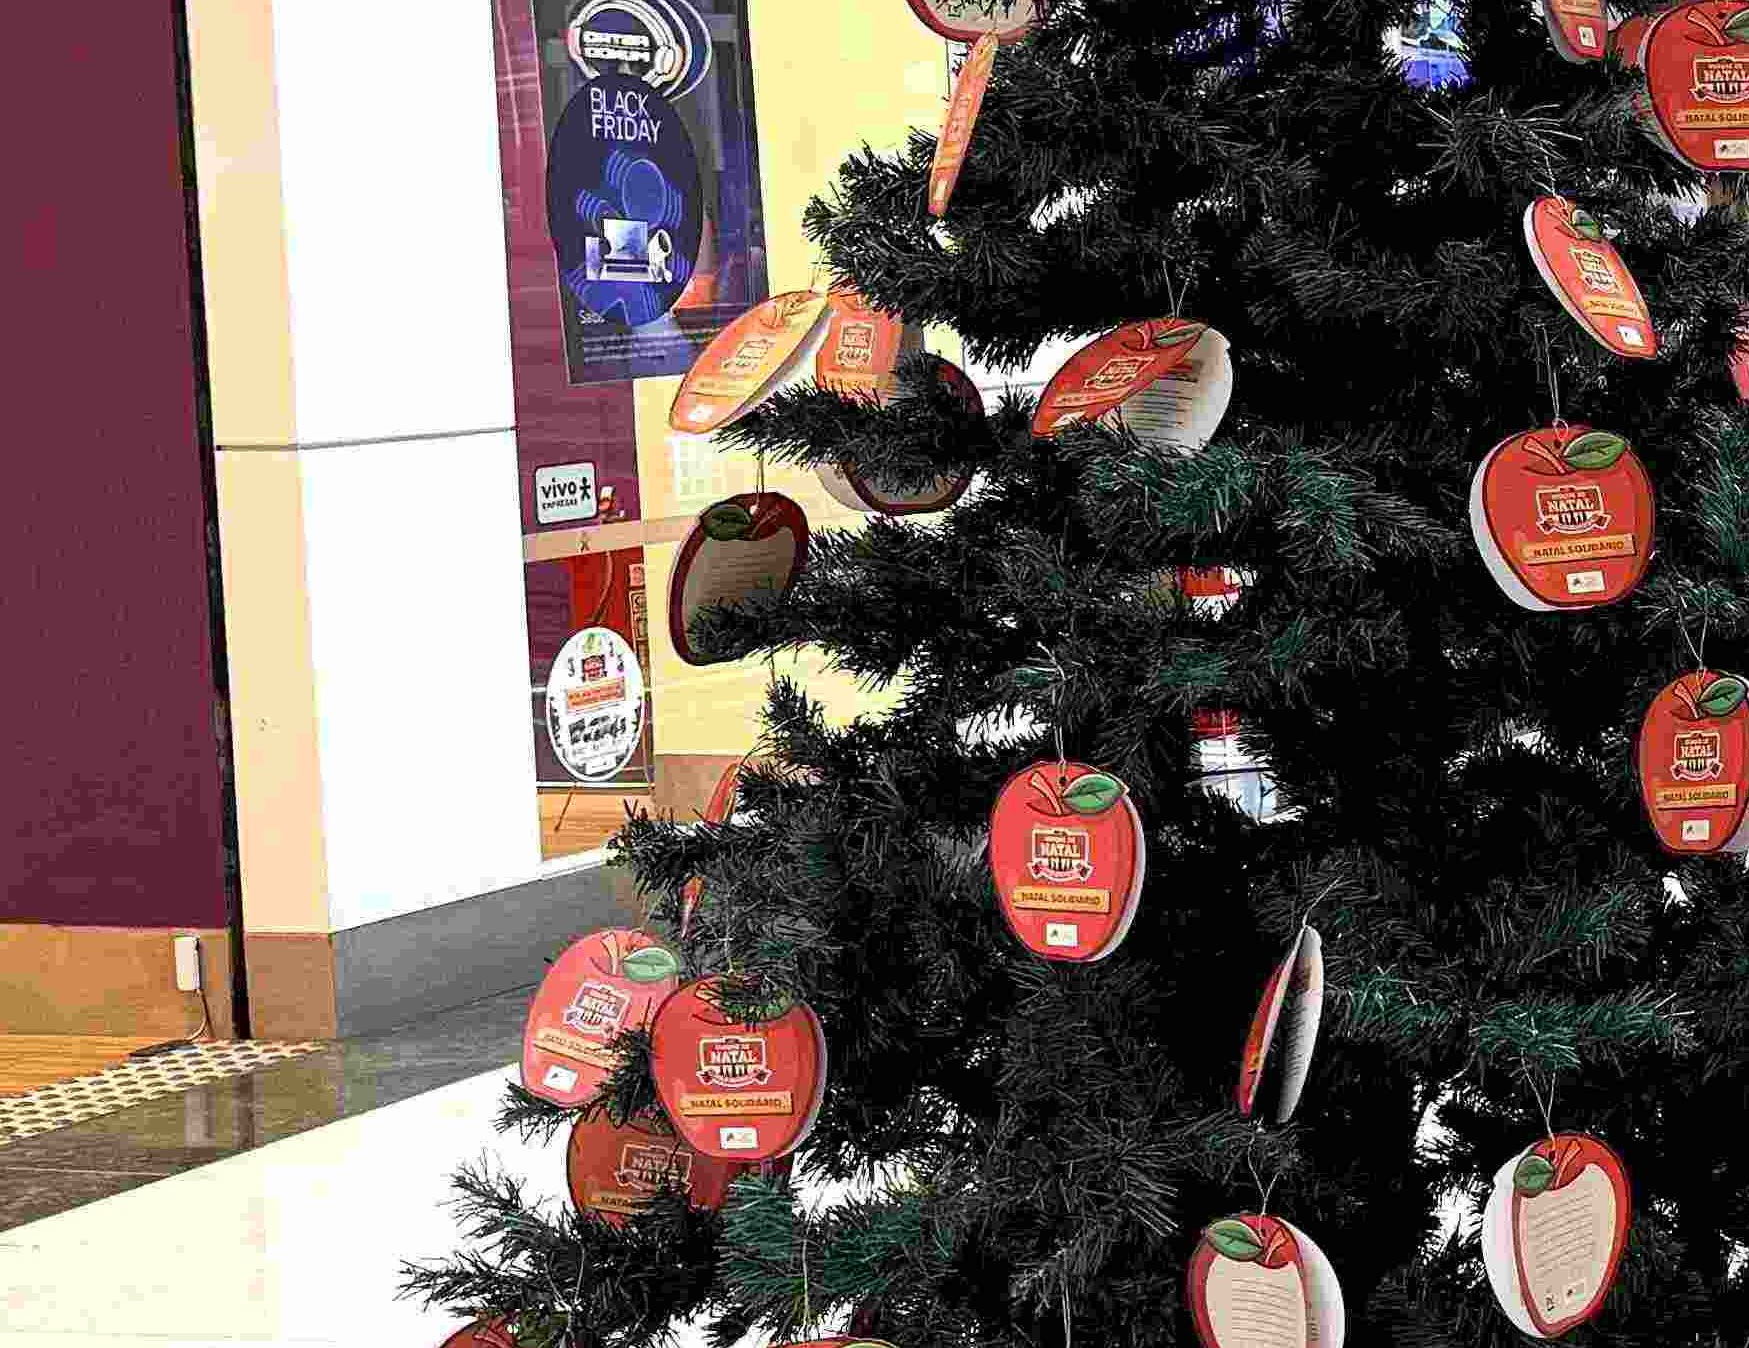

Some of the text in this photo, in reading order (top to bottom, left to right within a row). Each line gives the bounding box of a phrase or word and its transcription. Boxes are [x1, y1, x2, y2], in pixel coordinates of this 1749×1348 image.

[589, 86, 650, 118] BLACK
[591, 113, 662, 145] FRIDAY
[541, 477, 579, 500] vivo
[1547, 496, 1596, 512] NATAL
[1680, 744, 1713, 758] NATAL
[1040, 842, 1082, 858] NATAL
[710, 1048, 759, 1065] NATAL
